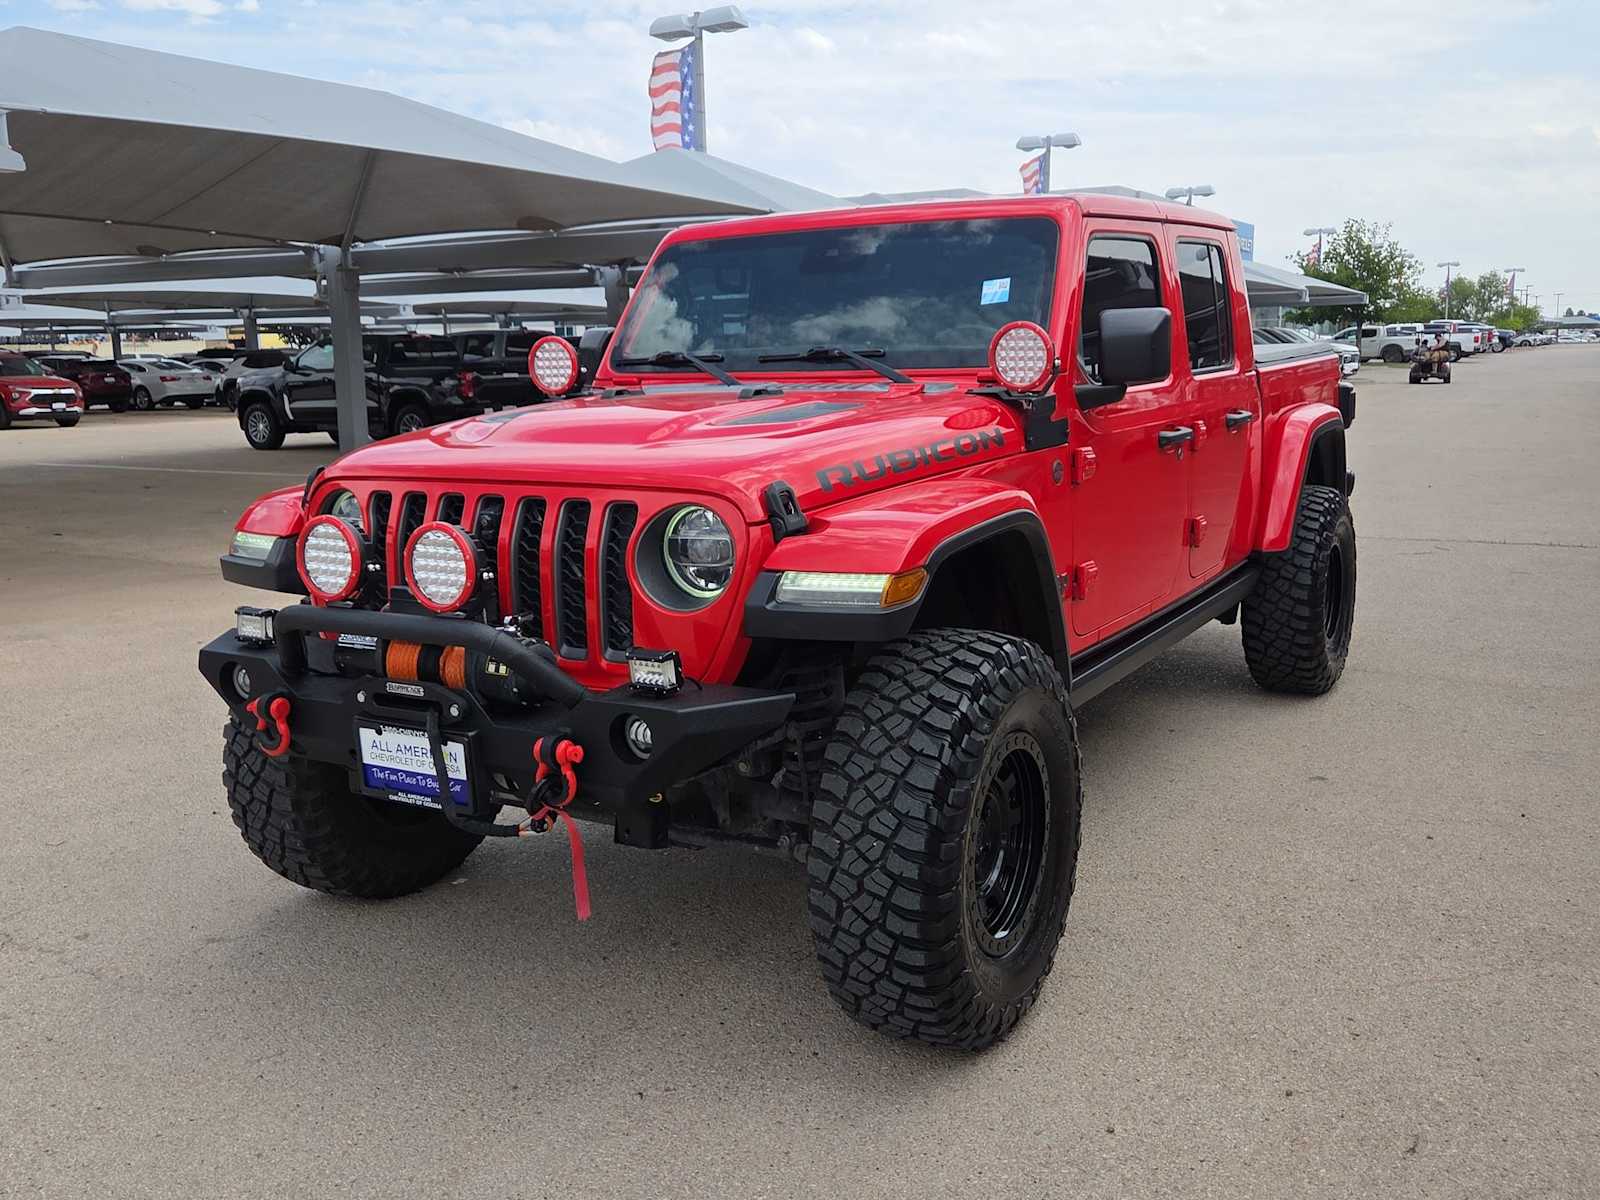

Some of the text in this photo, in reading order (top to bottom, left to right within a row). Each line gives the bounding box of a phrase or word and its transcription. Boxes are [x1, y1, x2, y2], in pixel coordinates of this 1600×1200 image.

[815, 427, 1005, 492] RUBICON
[371, 740, 392, 753] ALL
[370, 752, 414, 767] CHEVROLET
[416, 760, 425, 768] OF
[372, 768, 384, 779] The
[385, 771, 398, 782] Fun
[398, 772, 416, 785] Place
[417, 776, 425, 787] To
[426, 778, 440, 793] Buy
[388, 794, 415, 804] CHEVROLET
[423, 801, 442, 809] ODESSA
[407, 793, 431, 802] AMERICAN
